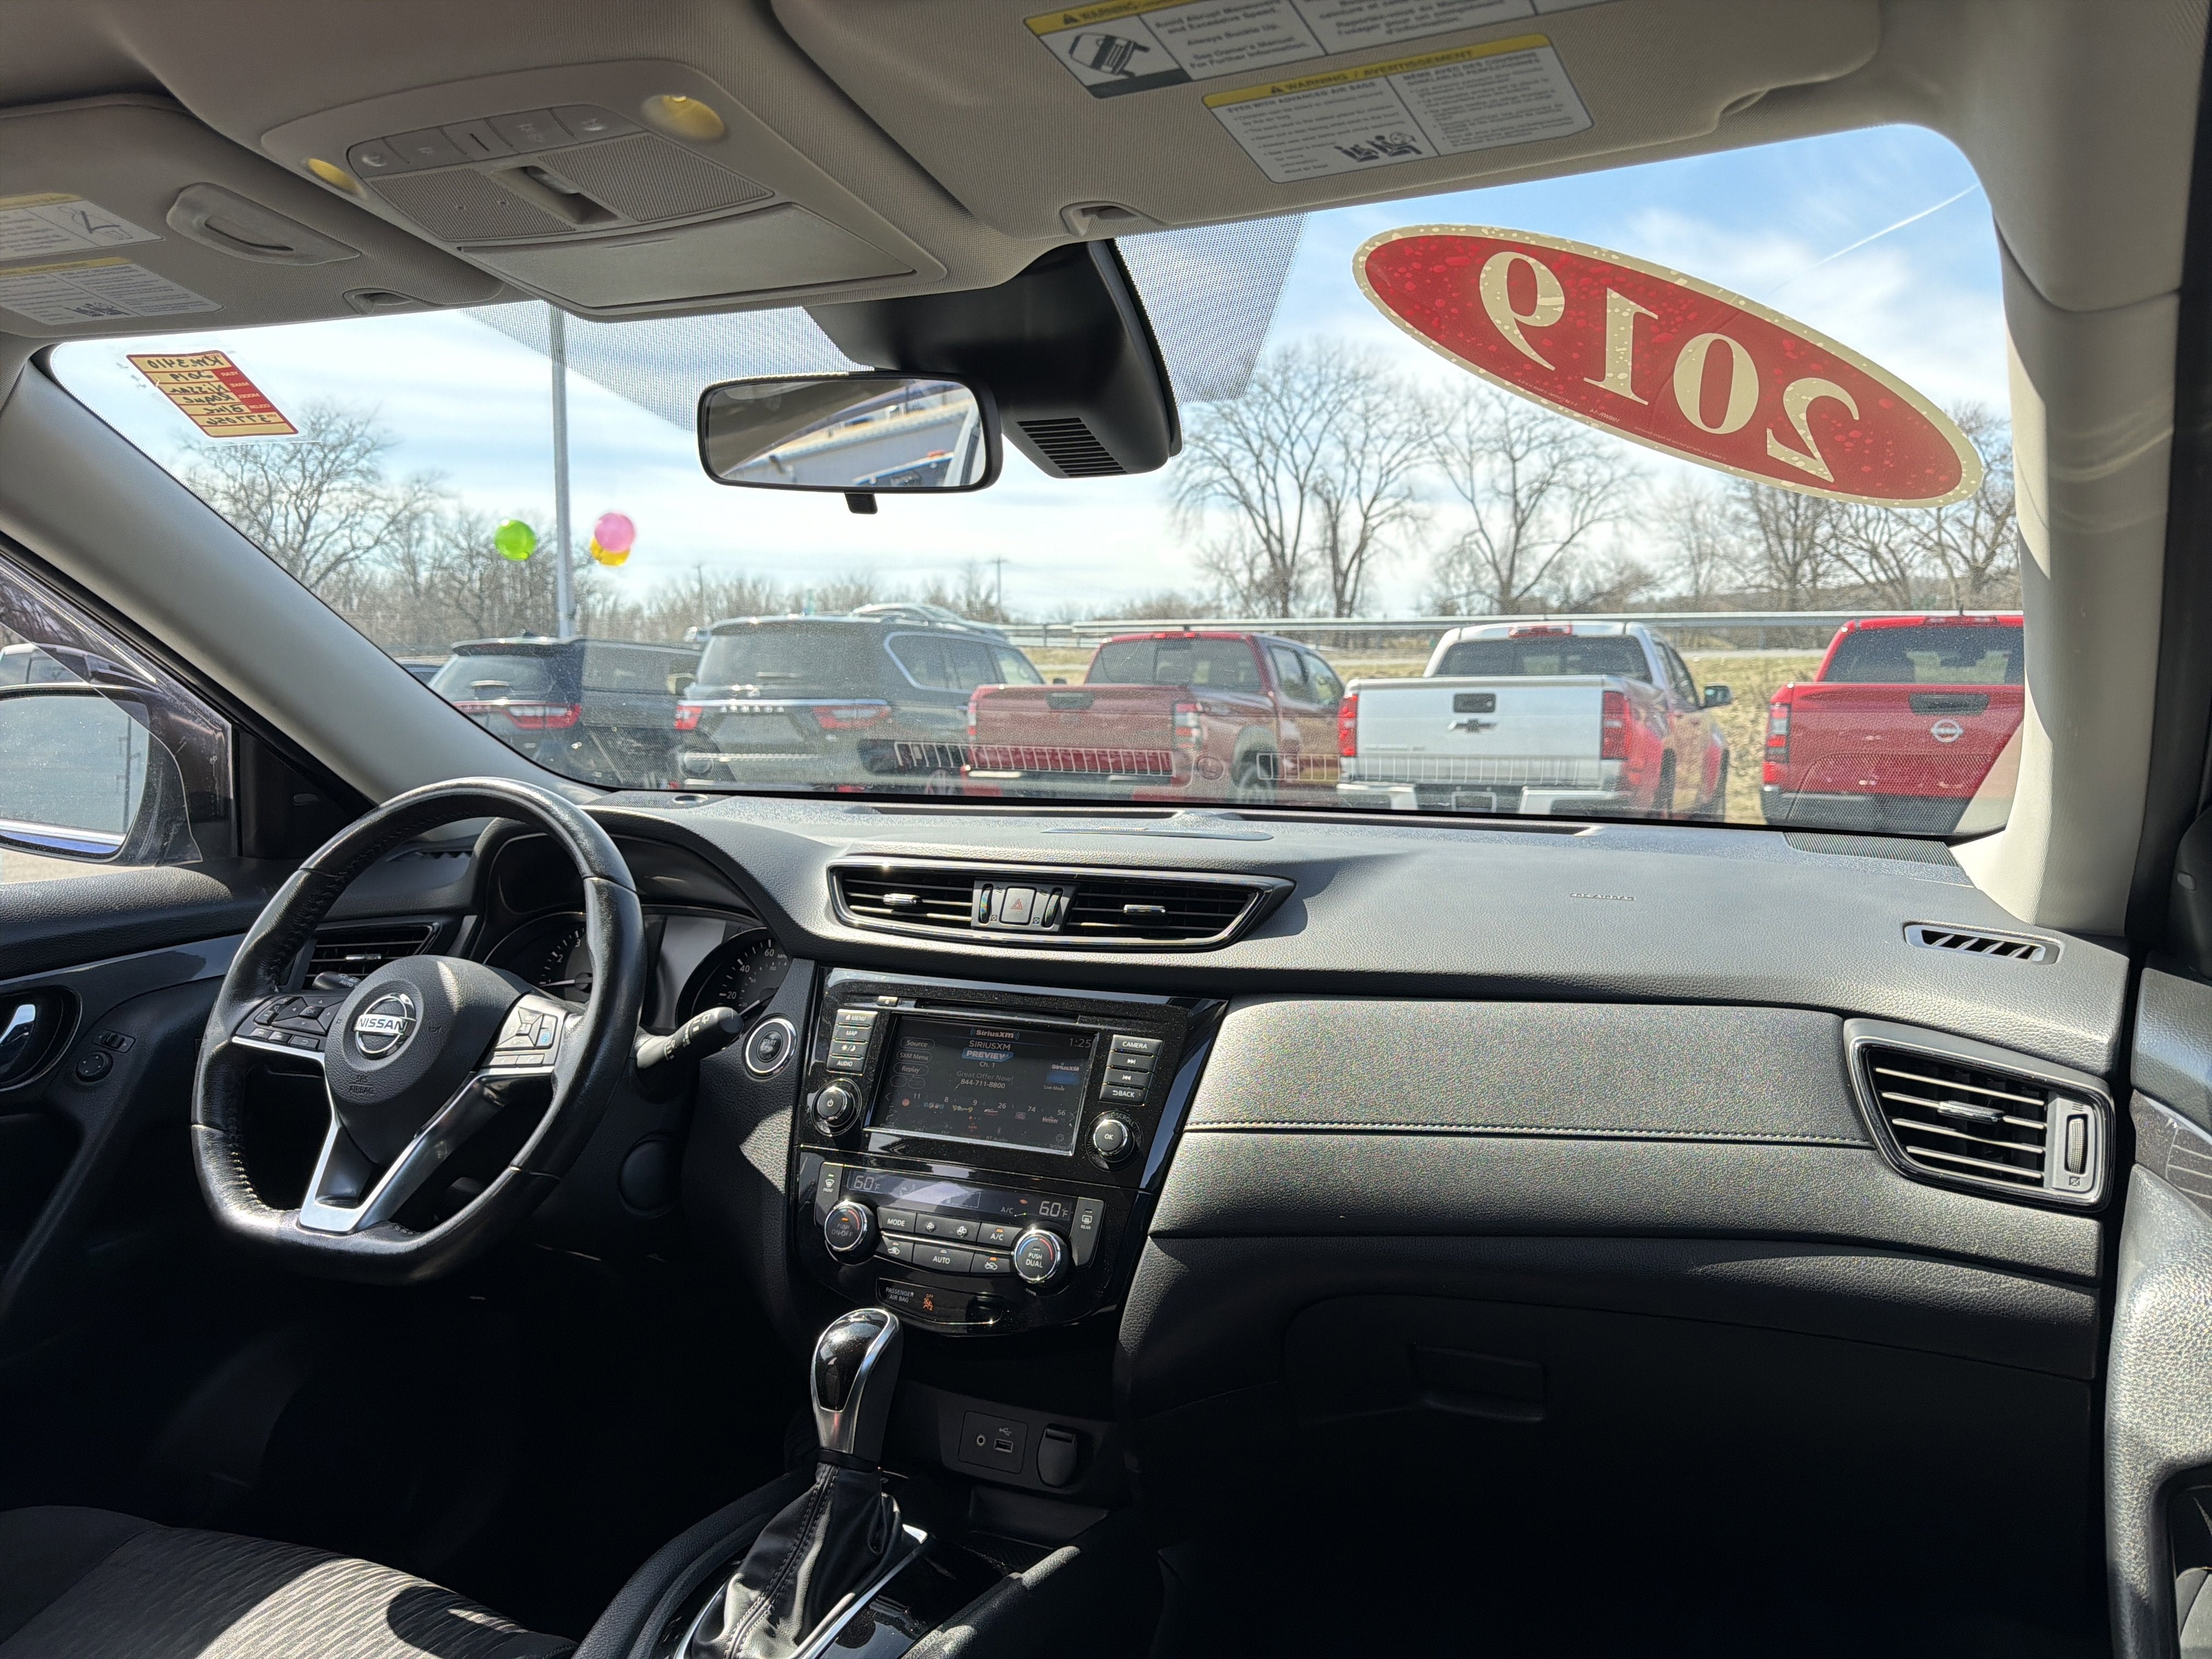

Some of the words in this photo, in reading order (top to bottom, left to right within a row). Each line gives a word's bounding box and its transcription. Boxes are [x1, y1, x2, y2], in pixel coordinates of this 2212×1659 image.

[575, 939, 580, 947] 3
[764, 949, 775, 957] 60
[557, 954, 563, 962] 2
[740, 964, 750, 973] 40
[358, 1018, 407, 1031] NISSAN
[969, 1040, 1011, 1051] SIRIUSXM
[1068, 1038, 1092, 1048] 1:25
[1122, 1041, 1148, 1049] CAMERA
[966, 1050, 1008, 1060] PREVIEW
[901, 1065, 921, 1074] Replay
[957, 1070, 976, 1079] Great
[977, 1072, 994, 1080] Offer
[996, 1074, 1014, 1082] Now!
[961, 1079, 1006, 1089] 844-711-8800
[349, 1086, 375, 1094] AIRBAG
[1000, 1206, 1014, 1215] A/C
[887, 1218, 906, 1227] MODE
[990, 1233, 1004, 1242] A/C
[932, 1255, 951, 1265] AUTO
[1028, 1252, 1043, 1260] PUSH
[1025, 1259, 1043, 1268] DUAL
[885, 1287, 915, 1298] PASSENGER
